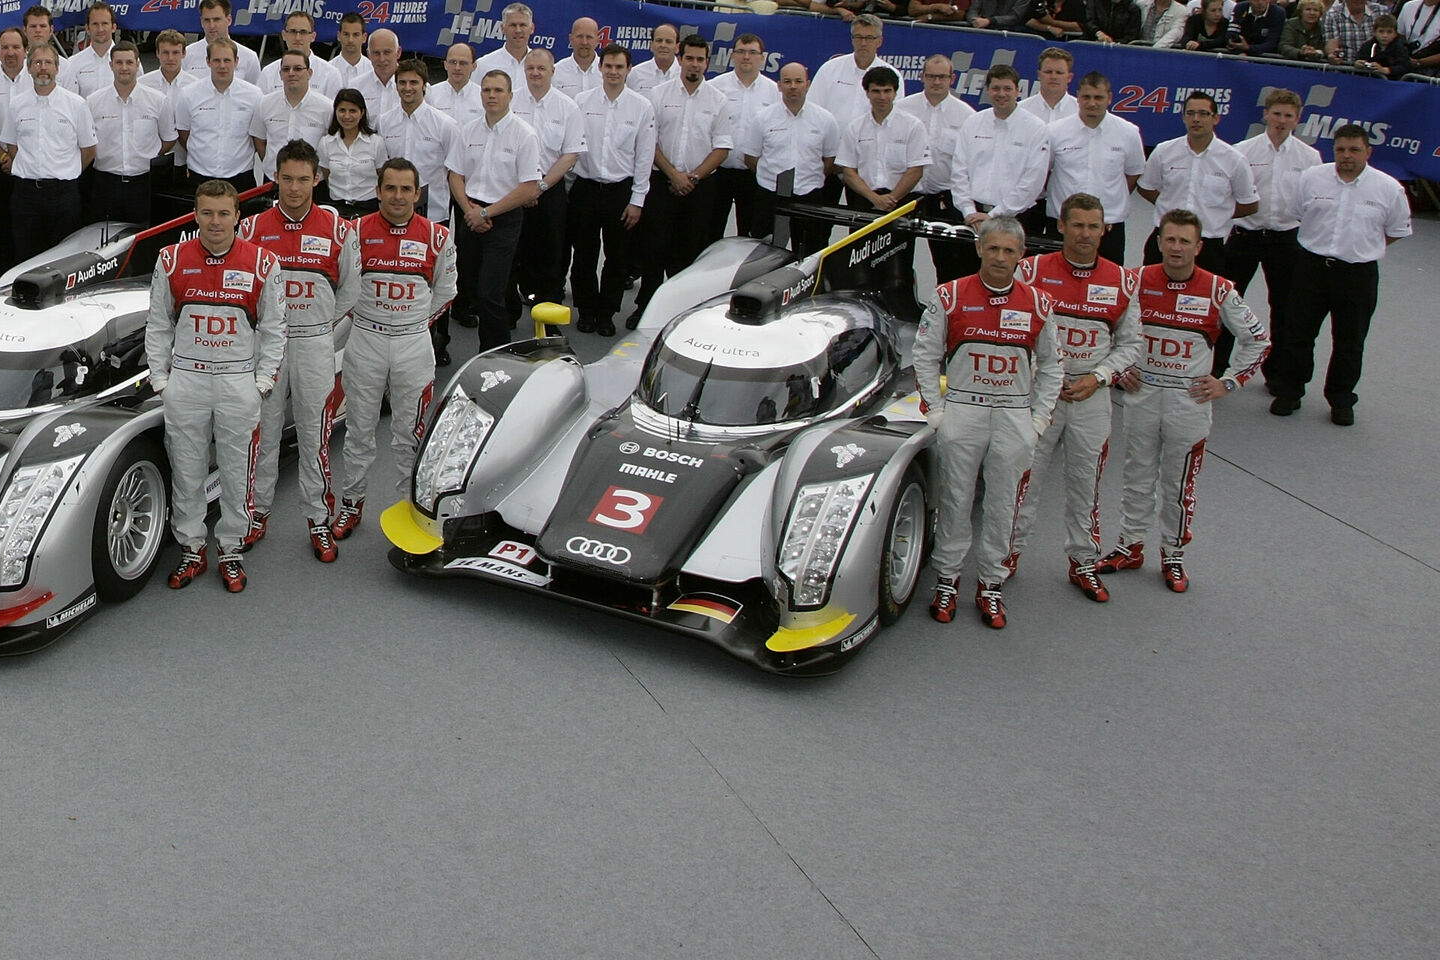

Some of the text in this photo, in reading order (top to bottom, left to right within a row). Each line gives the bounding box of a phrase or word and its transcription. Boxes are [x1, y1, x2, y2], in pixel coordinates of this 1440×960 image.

[2, 0, 21, 13] MANS
[357, 0, 427, 24] 24 HEURES
[390, 12, 427, 24] DU MANS
[449, 14, 471, 36] LE
[616, 26, 653, 40] HEURE
[955, 72, 981, 96] LE
[1111, 84, 1171, 113] 24
[848, 232, 892, 268] Audi ultra
[297, 255, 321, 265] Sport
[377, 258, 422, 268] Audi Sport
[77, 257, 118, 284] Audi Sport
[196, 289, 244, 300] Audi Sport
[285, 280, 315, 298] DI
[371, 279, 416, 300] TDI
[789, 274, 815, 300] Audi Sport
[375, 300, 411, 311] Power
[1058, 300, 1108, 314] Audi Sport
[189, 314, 238, 335] TDI
[1153, 311, 1204, 325] Audi Sport
[194, 336, 234, 347] Power
[976, 328, 1027, 340] Audi Sport
[1057, 326, 1099, 347] TDI
[682, 335, 761, 359] Audi ultra
[1062, 349, 1093, 359] ower
[1140, 333, 1194, 359] TDI
[968, 352, 1019, 374] TDI
[1146, 357, 1188, 371] Power
[973, 374, 1014, 386] Power
[643, 447, 704, 468] BOSCH
[619, 463, 678, 484] MAHLE
[595, 489, 652, 529] 3
[496, 543, 531, 560] P1
[475, 561, 527, 578] MANS
